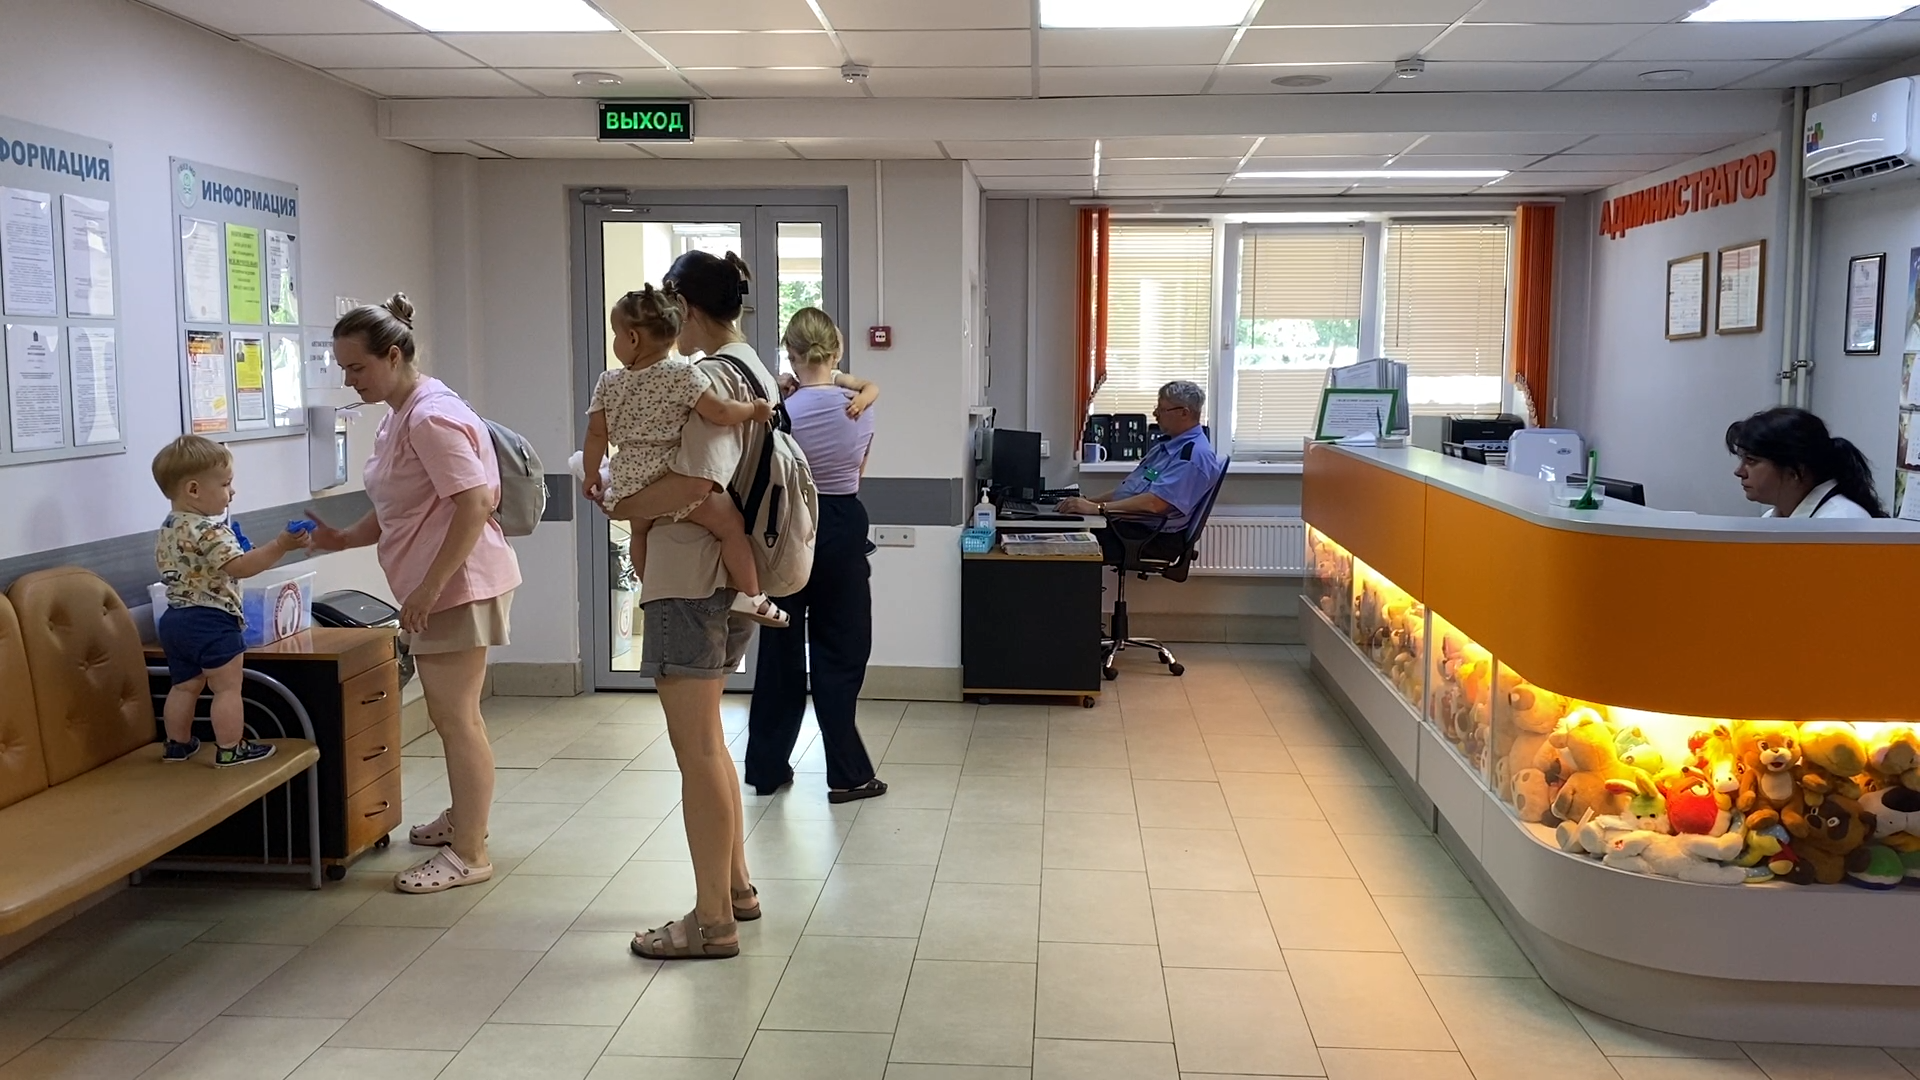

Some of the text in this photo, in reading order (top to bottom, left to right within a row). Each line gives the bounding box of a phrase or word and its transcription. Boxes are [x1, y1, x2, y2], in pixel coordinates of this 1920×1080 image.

[606, 111, 684, 132] ВЫХОД
[202, 180, 297, 218] ИНФОРМАЦИЯ
[1598, 149, 1777, 240] АДМИНИСТРАТОР
